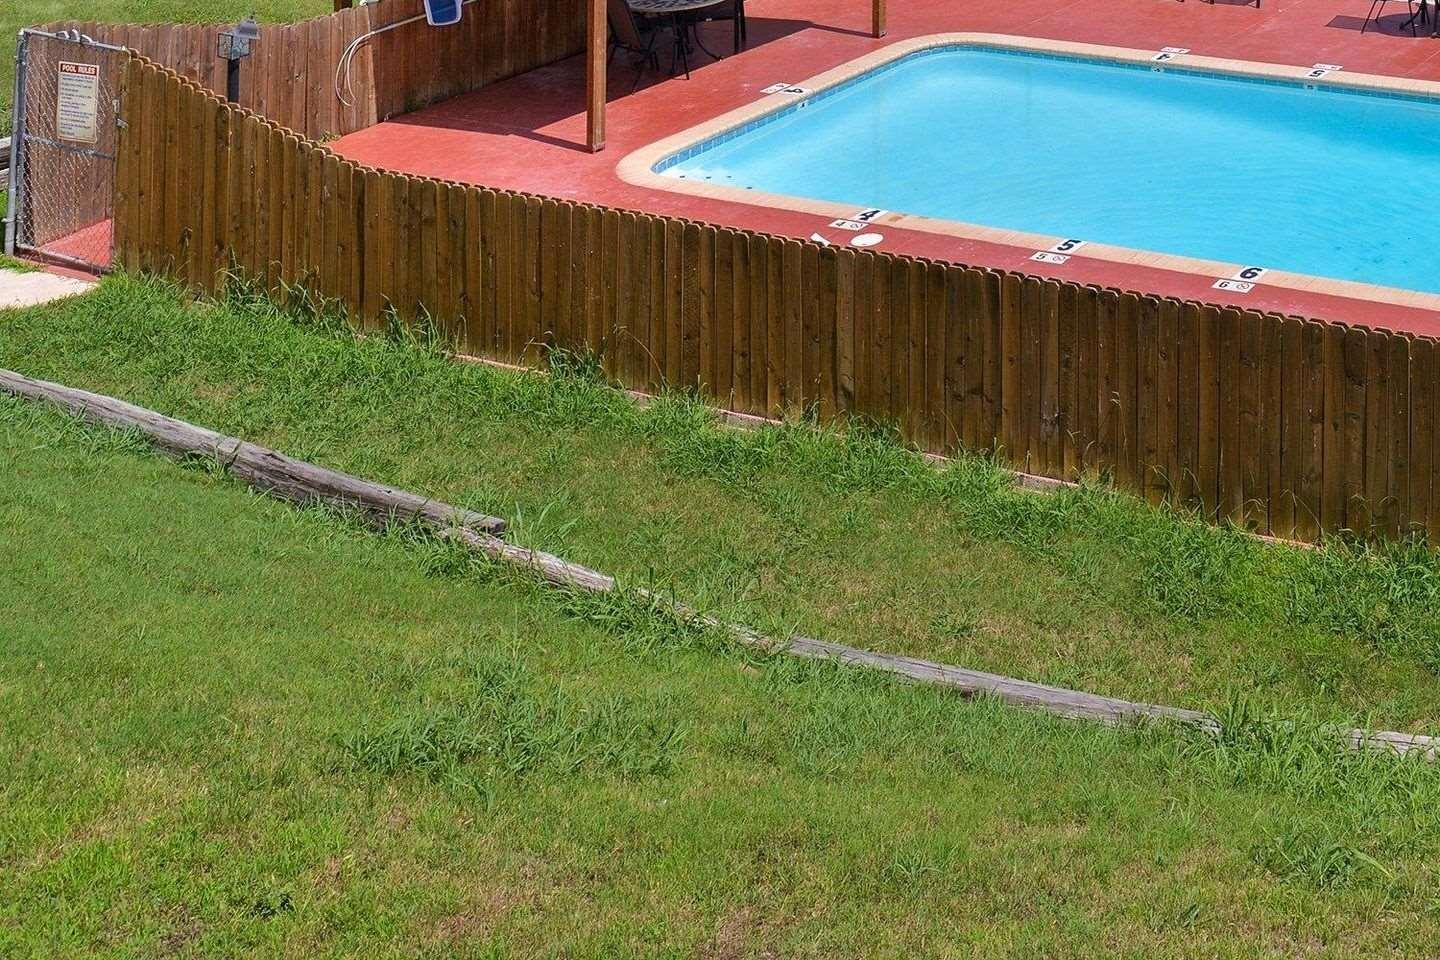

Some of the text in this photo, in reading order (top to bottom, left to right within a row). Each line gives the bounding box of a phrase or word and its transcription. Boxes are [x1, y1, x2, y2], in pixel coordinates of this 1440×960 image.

[61, 63, 96, 76] POOL RULES
[859, 209, 881, 220] 4
[1057, 239, 1082, 251] 5
[1240, 267, 1263, 279] 6
